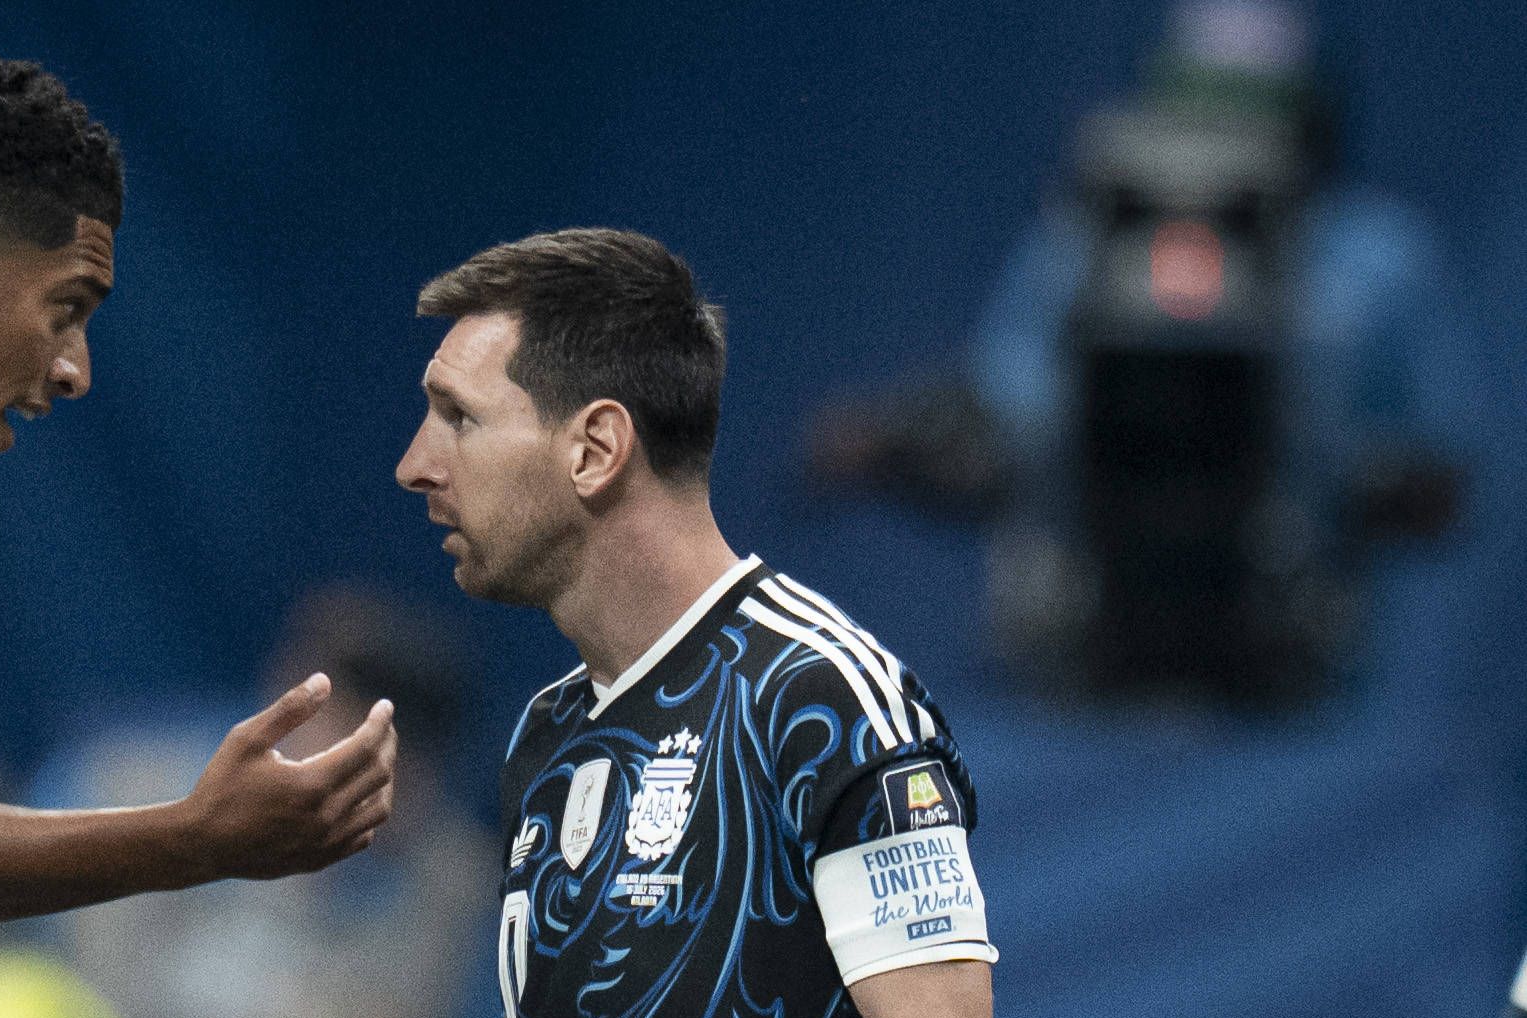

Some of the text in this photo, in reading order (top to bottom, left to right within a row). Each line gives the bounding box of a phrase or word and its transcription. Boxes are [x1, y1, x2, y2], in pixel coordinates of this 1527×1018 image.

[570, 826, 589, 841] FIFA
[862, 837, 958, 873] FOOTBALL
[869, 857, 964, 900] UNITES
[869, 884, 974, 928] the World
[911, 919, 950, 938] FIFA
